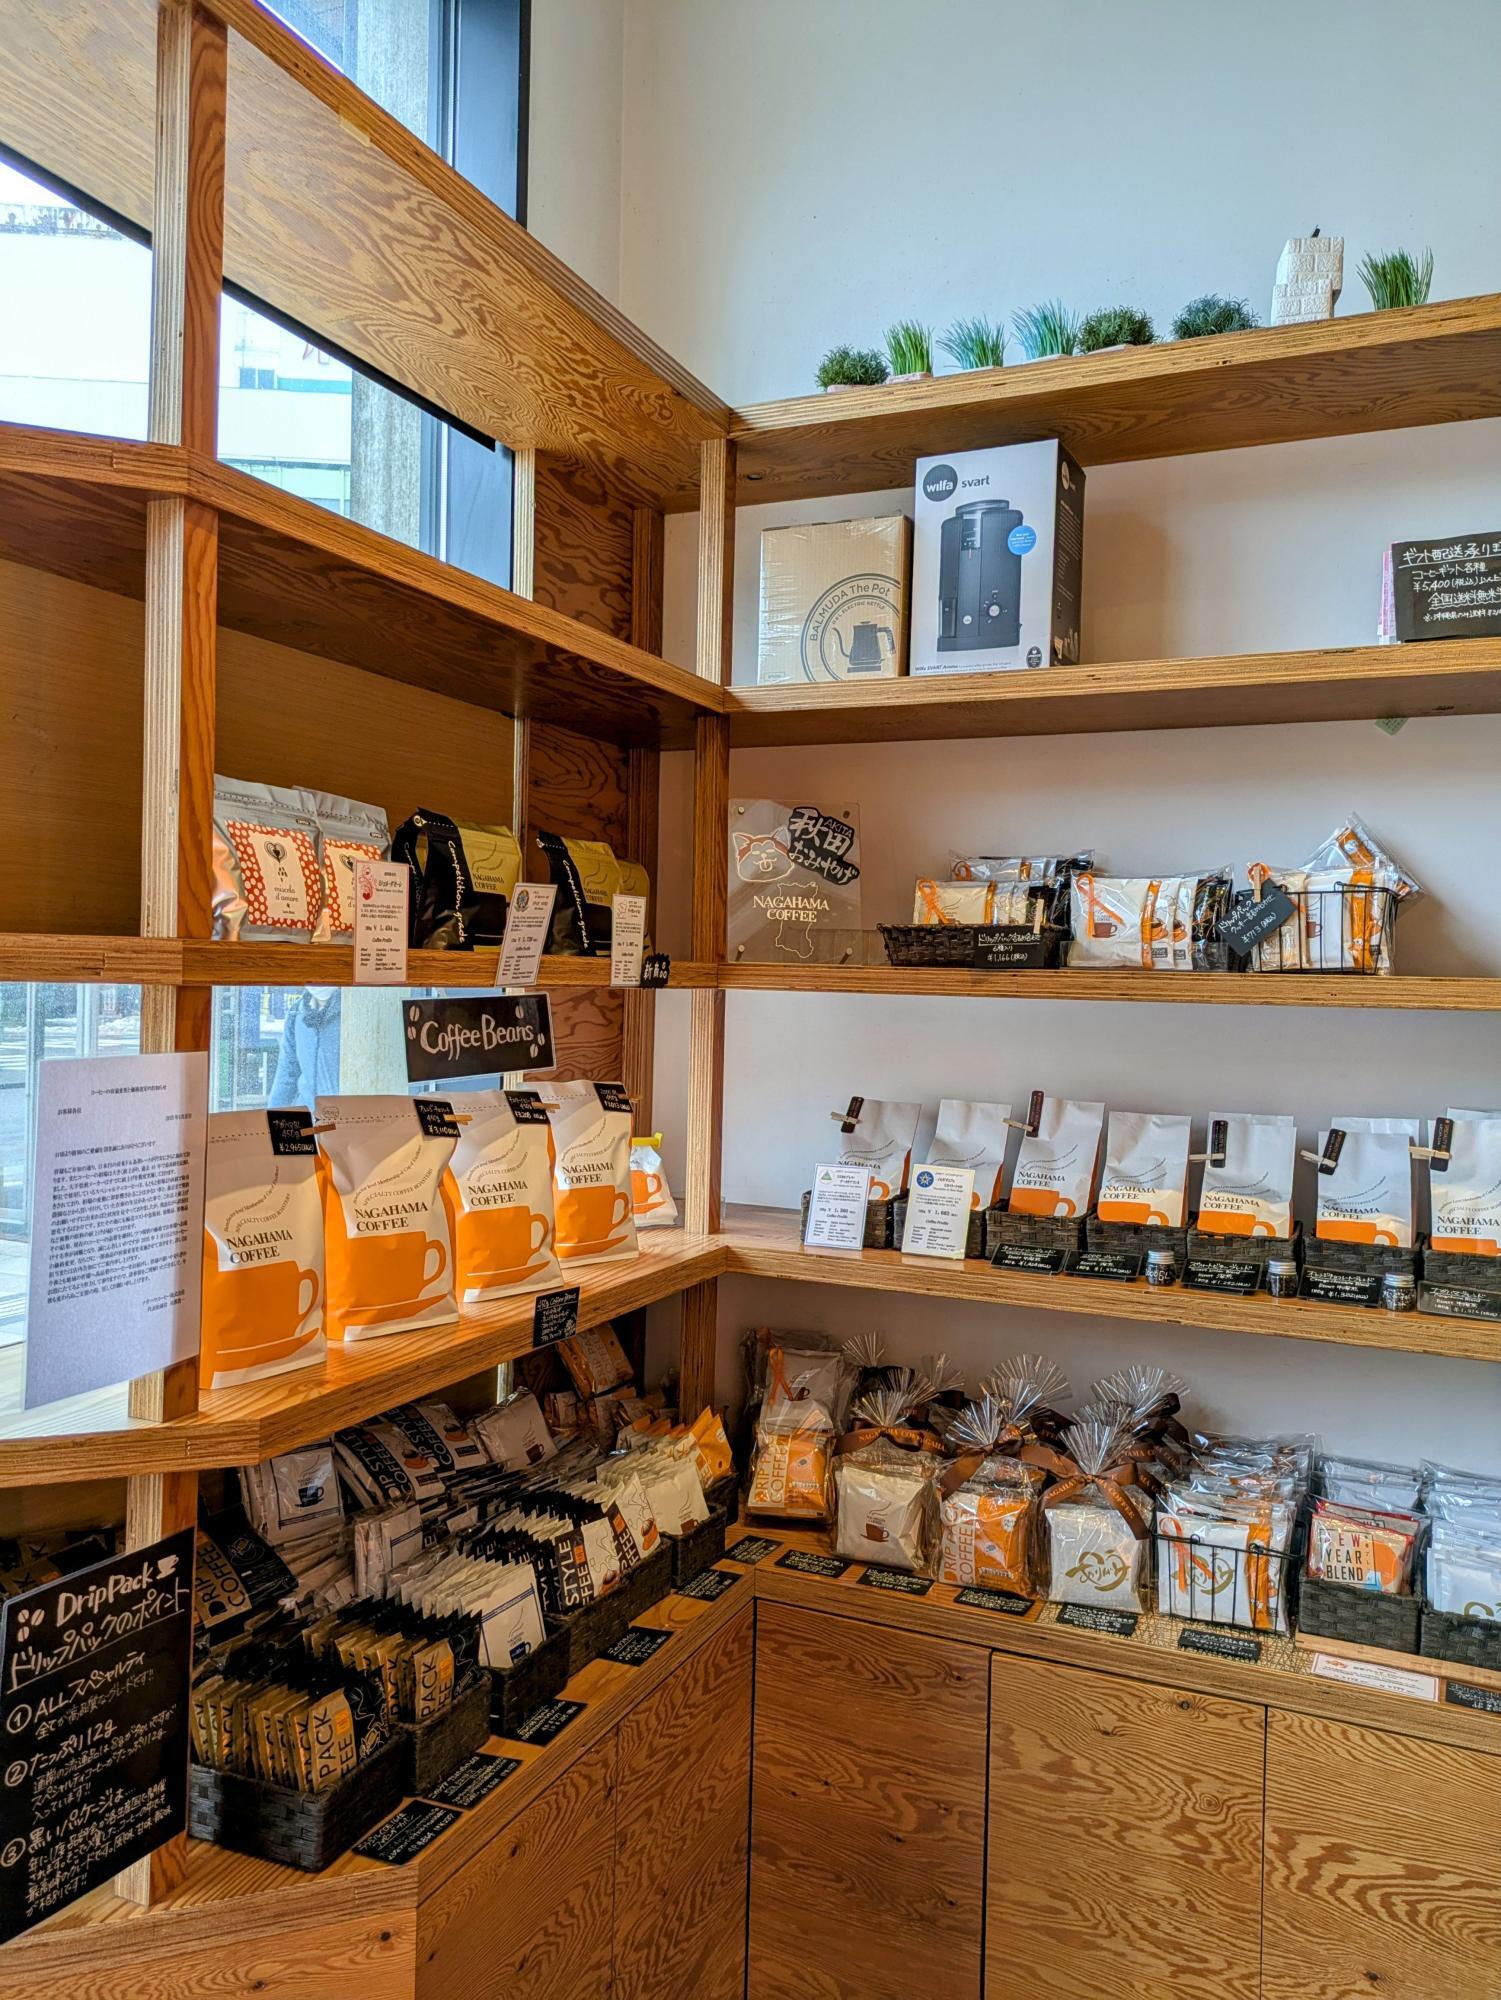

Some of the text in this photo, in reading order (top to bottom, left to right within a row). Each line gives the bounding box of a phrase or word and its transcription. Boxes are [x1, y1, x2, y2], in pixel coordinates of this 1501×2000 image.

[926, 480, 953, 493] wilfa
[961, 475, 990, 488] svart
[810, 583, 891, 641] BALMUDA The Pot
[789, 808, 851, 856] 秋田
[823, 818, 853, 838] AKITA
[788, 840, 858, 884] おみやげ
[473, 873, 505, 884] NAGAHAMA
[474, 882, 498, 891] COFFEE
[753, 895, 829, 911] NAGAHAMA
[766, 908, 817, 923] COFFEE
[562, 1161, 615, 1175] NAGAHAMA
[564, 1173, 603, 1185] COFFEE
[1016, 1178, 1051, 1188] COFFEE
[1018, 1171, 1066, 1182] NAGAHAMA
[392, 1187, 414, 1196] COFFEE
[468, 1180, 528, 1195] NAGAHAMA
[1104, 1185, 1156, 1194] NAGAHAMA
[470, 1193, 516, 1207] COFFEE
[1103, 1192, 1140, 1200] COFFEE
[1205, 1195, 1260, 1207] NAGAHAMA
[355, 1201, 428, 1219] NAGAHAMA
[1203, 1202, 1244, 1211] COFFEE
[1322, 1204, 1380, 1214] NAGAHAMA
[1321, 1211, 1363, 1220] COFFEE
[1437, 1216, 1500, 1227] NAGAHAMA
[356, 1216, 409, 1232] COFFEE
[1437, 1225, 1481, 1235] COFFEE
[227, 1229, 293, 1249] NAGAHAMA
[229, 1245, 281, 1264] COFFEE
[415, 1418, 452, 1466] COFFEE
[370, 1443, 413, 1494] COFFEE
[1326, 1549, 1362, 1565] YEAR
[203, 1545, 246, 1607] COFFEE
[558, 1539, 580, 1607] STYLE
[1326, 1565, 1363, 1581] BLEND
[11, 1577, 190, 1690] ドリップパックのポイント
[421, 1653, 438, 1718] PACK
[313, 1705, 338, 1780] PACK
